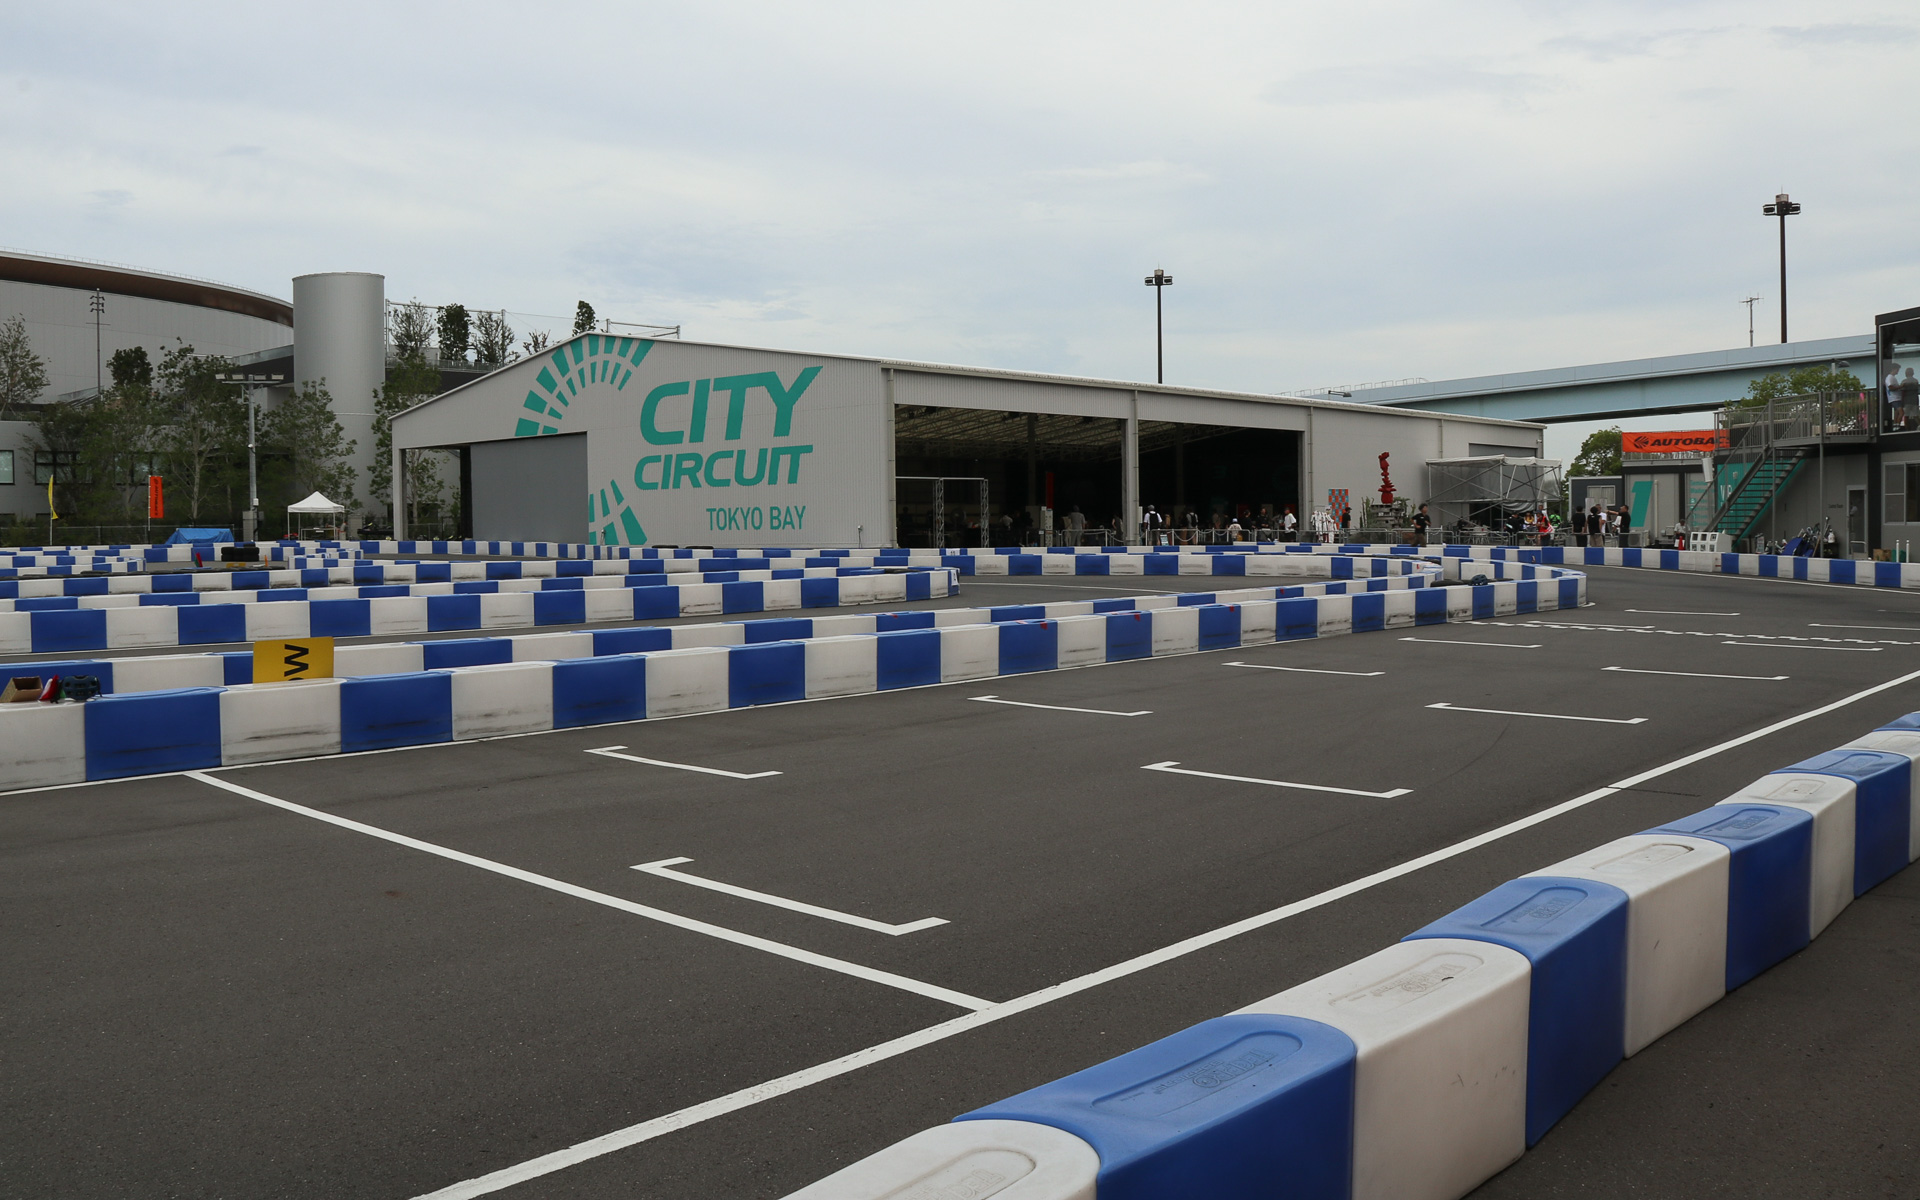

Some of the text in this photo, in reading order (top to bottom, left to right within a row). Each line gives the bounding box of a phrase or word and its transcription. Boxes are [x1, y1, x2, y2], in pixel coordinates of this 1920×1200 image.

[640, 366, 823, 445] CITY
[634, 445, 814, 490] CIRCUIT
[706, 505, 807, 531] TOKYO BAY
[1629, 480, 1654, 528] 1
